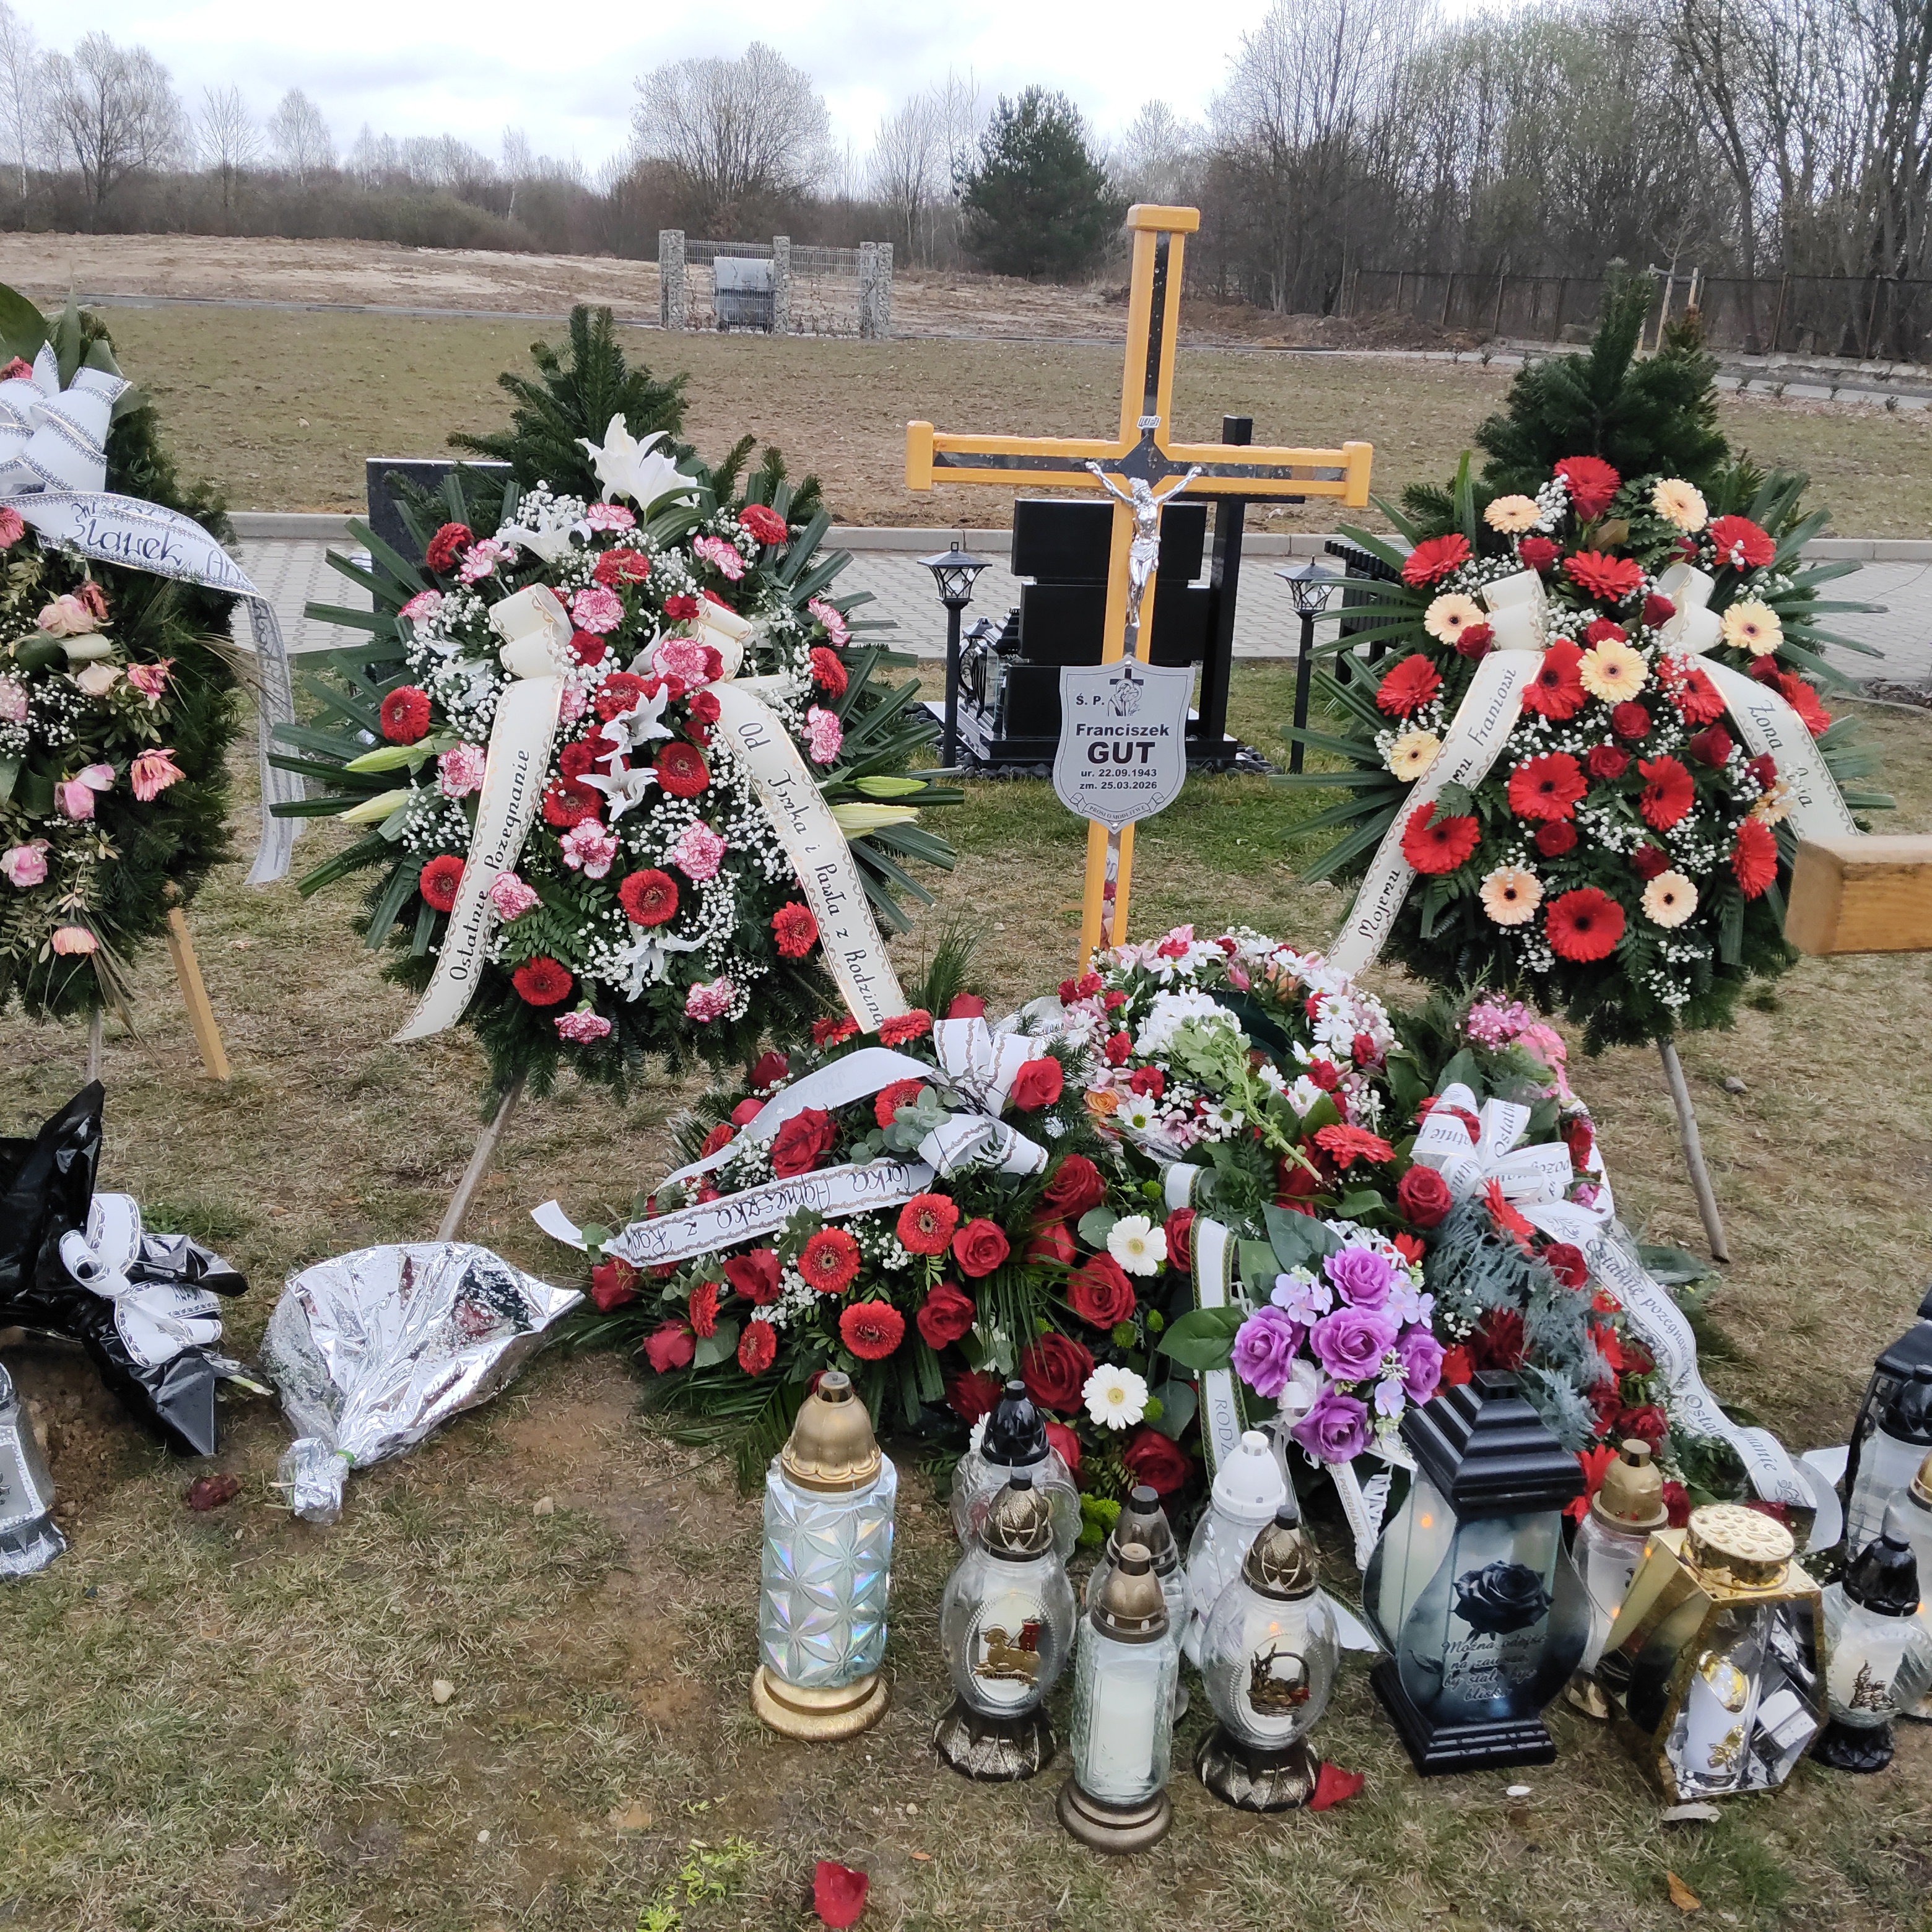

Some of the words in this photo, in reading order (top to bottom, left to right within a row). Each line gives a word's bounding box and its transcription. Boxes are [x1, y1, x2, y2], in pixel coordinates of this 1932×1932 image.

[1076, 692, 1088, 706] Ś.
[1092, 696, 1105, 706] P.
[1467, 668, 1516, 747] Franiowi
[1075, 723, 1170, 737] Franciszek
[1087, 741, 1155, 764] GUT
[1098, 768, 1157, 777] 22.09.1943
[1100, 781, 1157, 790] 25.03.2026
[738, 722, 772, 752] Od
[804, 843, 821, 854] i
[814, 862, 847, 917] Pawła
[835, 928, 849, 939] z
[449, 889, 489, 981] Ostatnie
[484, 749, 529, 870] Pożegnanie
[1358, 870, 1401, 941] Mojemu
[715, 1174, 831, 1229] Agnieszka
[682, 1221, 697, 1237] z
[1214, 1398, 1236, 1458] RODZ
